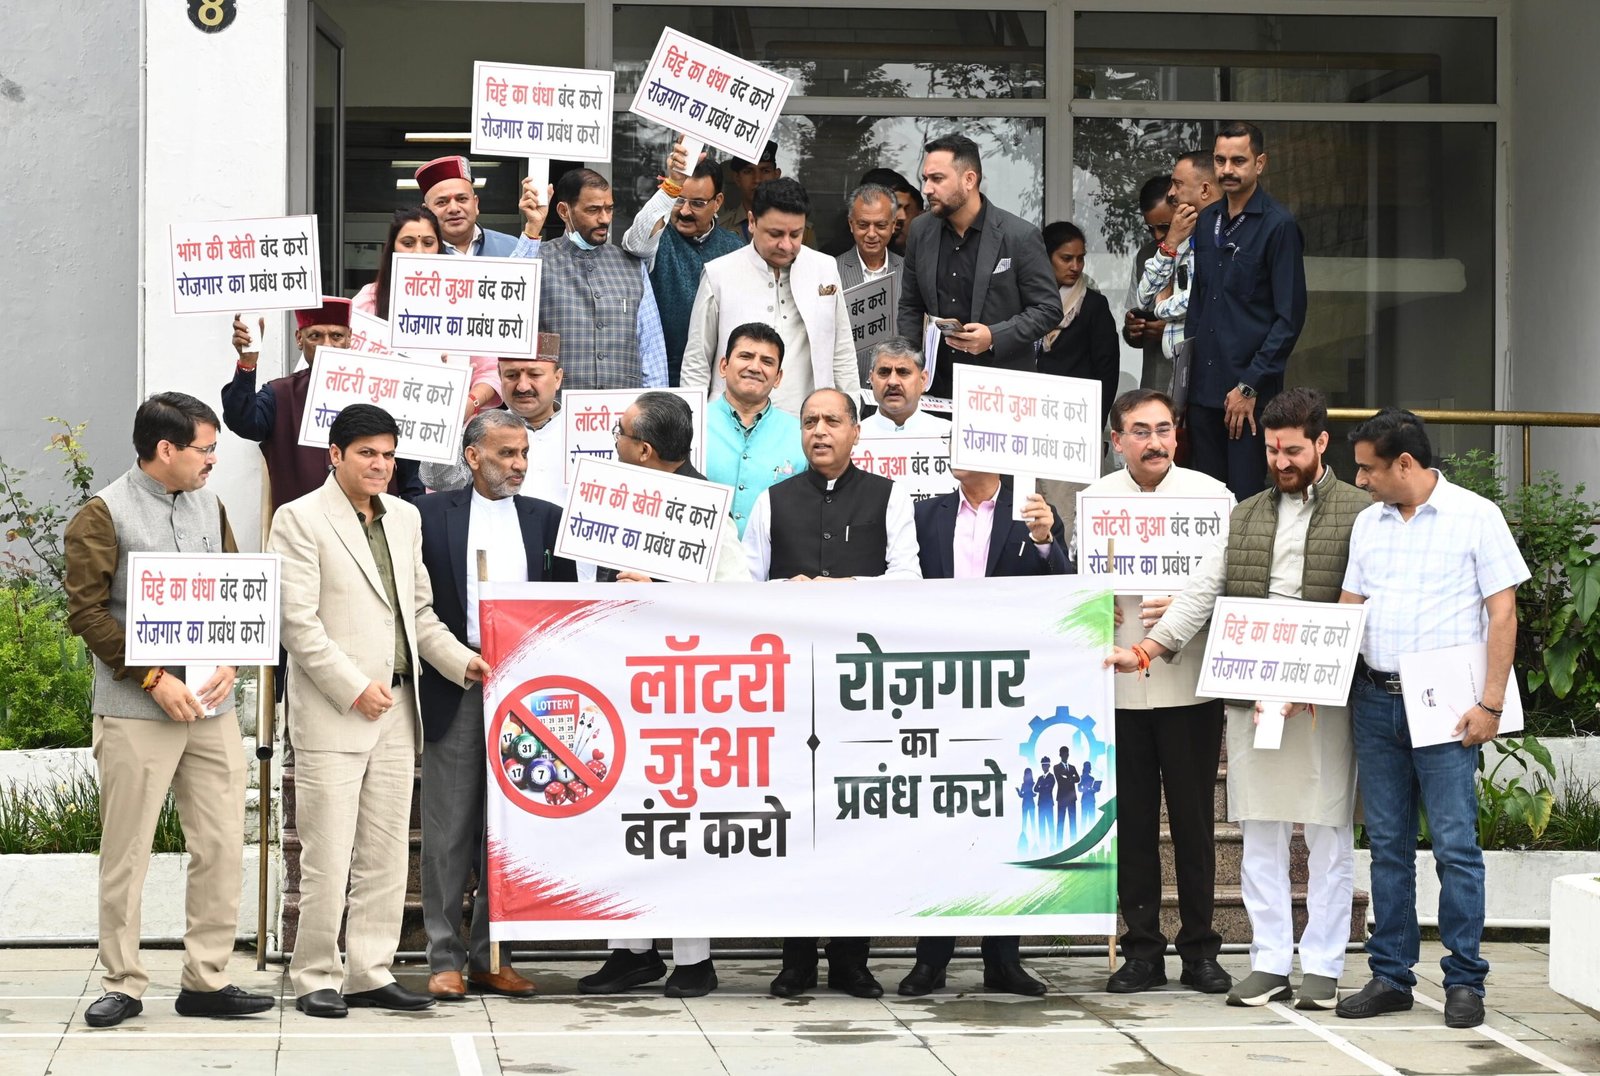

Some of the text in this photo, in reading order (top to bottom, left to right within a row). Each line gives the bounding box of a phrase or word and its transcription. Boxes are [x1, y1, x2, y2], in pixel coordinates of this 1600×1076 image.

[198, 0, 224, 26] 8
[486, 76, 602, 110] चिट्टे का धंधा बंद करो
[662, 45, 774, 112] चिट्टे का धंधा बंद करो
[648, 78, 760, 143] रोज़गार का प्रबंध करो
[481, 112, 600, 145] रोज़गार का प्रबंध करो
[177, 232, 308, 261] भांग की खेती बंद करो
[177, 266, 307, 296] रोज़गार का प्रबंध करो
[405, 271, 526, 304] लॉटरी जुआ बंद करो
[851, 287, 887, 316] बंद करो
[398, 308, 523, 339] रोज़गार का प्रबंध करो
[867, 313, 887, 335] करो
[326, 366, 454, 406] लॉटरी जुआ बंद करो
[575, 405, 610, 432] लॉटरी
[967, 385, 1004, 413] लॉटरी
[1008, 395, 1037, 422] जुआ
[1041, 394, 1059, 420] बंद
[1063, 397, 1088, 423] करो
[420, 419, 446, 444] करो
[963, 424, 1086, 462] रोज़गार का प्रबंध करो
[910, 451, 930, 476] बंद
[580, 479, 718, 530] भांग की खेती बंद करो
[569, 512, 707, 565] रोज़गार का प्रबंध करो
[1092, 509, 1221, 543] लॉटरी जुआ बंद करो
[1140, 555, 1158, 576] का
[1162, 551, 1190, 576] प्रबंध
[141, 569, 268, 606] चिट्टे का धंधा बंद करो
[136, 613, 265, 646] रोज़गार का प्रबंध करो
[1222, 613, 1351, 648] चिट्टे का धंधा बंद करो
[625, 633, 791, 714] लॉटरी
[836, 632, 1030, 720] रोज़गार
[1211, 651, 1341, 686] रोज़गार का प्रबंध करो
[536, 699, 574, 711] LOTTERY
[522, 744, 532, 753] 31
[899, 728, 939, 758] का
[512, 768, 521, 778] 17
[538, 770, 545, 779] 7
[563, 769, 568, 778] 1
[640, 727, 775, 809] जुआ
[834, 759, 1007, 820] प्रबंध करो
[621, 795, 791, 859] बंद करो
